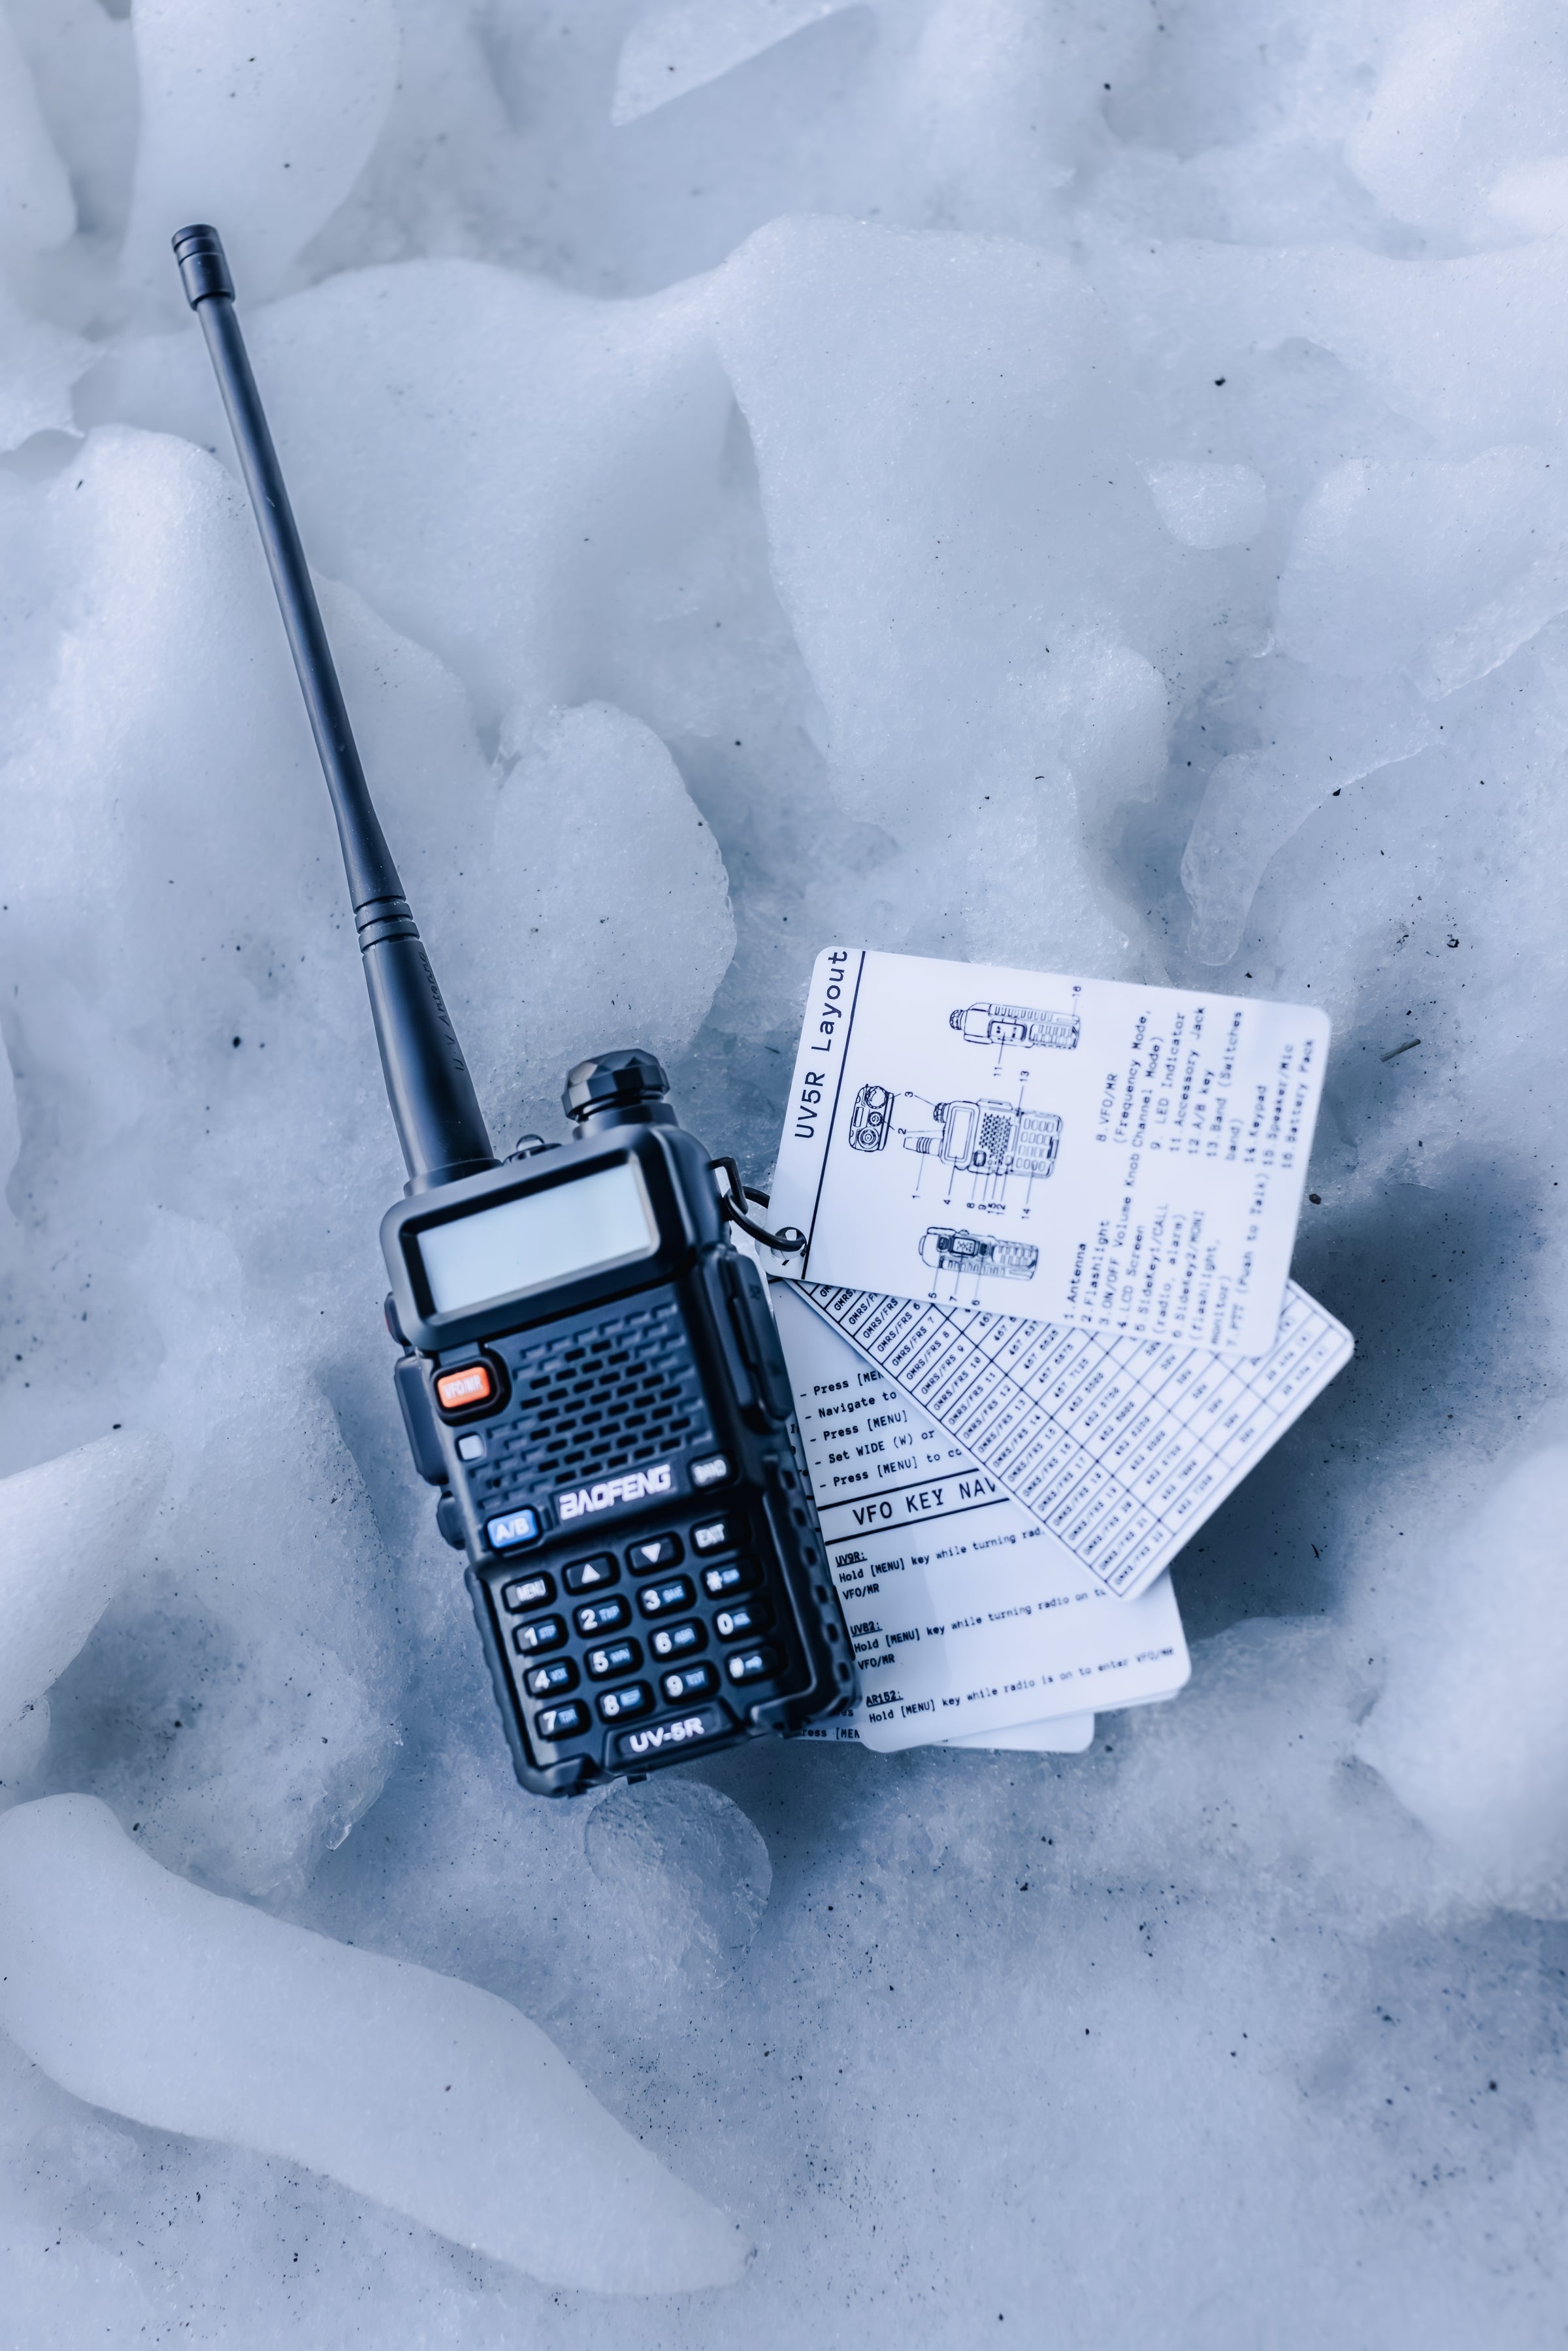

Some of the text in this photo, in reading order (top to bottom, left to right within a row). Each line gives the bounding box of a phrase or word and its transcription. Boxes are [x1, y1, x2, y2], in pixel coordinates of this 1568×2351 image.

[1190, 1008, 1205, 1040] Jack
[794, 951, 847, 1138] UV5R Layout
[1161, 1012, 1186, 1089] Indicator
[1217, 1011, 1243, 1087] (Switches
[1298, 1040, 1314, 1073] Pack
[993, 1067, 1002, 1077] 11
[1020, 1070, 1030, 1081] 13
[1113, 1011, 1151, 1143] (Frequency Mode,
[1131, 1036, 1164, 1147] Channel Mode)
[1198, 1070, 1215, 1094] key
[1155, 1097, 1170, 1125] LED
[1224, 1118, 1245, 1162] band)
[1022, 1209, 1030, 1219] 14
[1112, 1196, 1132, 1247] Volume
[1124, 1153, 1141, 1188] Knob
[1249, 1173, 1270, 1215] Talk)
[1125, 1225, 1144, 1277] Screen
[1166, 1214, 1187, 1266] alarm)
[1245, 1223, 1260, 1242] to
[1235, 1251, 1254, 1294] (Push
[863, 1296, 898, 1338] GMRS/FRS
[1210, 1275, 1233, 1345] monitor)
[877, 1311, 913, 1352] GMRS/FRS
[892, 1326, 927, 1366] GMRS/FRS
[906, 1340, 941, 1380] GMRS/FRS
[921, 1355, 956, 1394] GMRS/FRS
[813, 1381, 849, 1396] Press
[934, 1371, 969, 1411] GMRS/FRS
[970, 1356, 981, 1368] 10
[948, 1385, 984, 1425] GMRS/FRS
[985, 1372, 996, 1383] 11
[818, 1397, 875, 1419] Navigate
[882, 1391, 897, 1401] to
[823, 1426, 858, 1441] Press
[867, 1410, 907, 1432] [MENU]
[828, 1450, 850, 1464] Set
[856, 1441, 885, 1456] WIDE
[893, 1433, 913, 1449] (W)
[921, 1430, 935, 1440] or
[833, 1471, 868, 1487] Press
[877, 1456, 917, 1478] [MENU]
[926, 1454, 940, 1463] to
[560, 1464, 672, 1519] BAOFENG
[852, 1501, 892, 1526] VFO
[906, 1488, 943, 1513] KEY
[496, 1517, 529, 1541] A/B
[516, 1524, 725, 1602] MENU EXIT
[835, 1551, 868, 1568] UV9R:
[839, 1527, 1041, 1583] Hold [MENU] key while turning rad
[842, 1583, 879, 1600] VFO/MR
[523, 1628, 538, 1647] 1
[580, 1609, 597, 1630] 2
[643, 1590, 661, 1611] 3
[850, 1620, 883, 1637] UV82:
[854, 1639, 879, 1653] Hold
[885, 1628, 920, 1648] [MENU]
[926, 1626, 945, 1636] key
[951, 1617, 982, 1630] while
[988, 1605, 1032, 1621] turning
[1038, 1597, 1069, 1610] radio
[1075, 1592, 1088, 1602] on
[534, 1670, 549, 1689] 4
[592, 1651, 608, 1673] 5
[655, 1632, 672, 1653] 6
[717, 1613, 734, 1635] 0
[857, 1653, 895, 1673] VFO/MR
[542, 1710, 560, 1731] 7
[602, 1695, 619, 1716] 8
[666, 1675, 683, 1696] 9
[866, 1690, 904, 1708] AR152:
[869, 1709, 894, 1723] Hold
[901, 1699, 935, 1718] [MENU]
[942, 1697, 960, 1706] key
[967, 1688, 998, 1701] while
[1004, 1681, 1035, 1693] radio
[1060, 1671, 1072, 1681] on
[1079, 1668, 1092, 1676] to
[1098, 1660, 1127, 1671] enter
[629, 1717, 704, 1752] UV-5R
